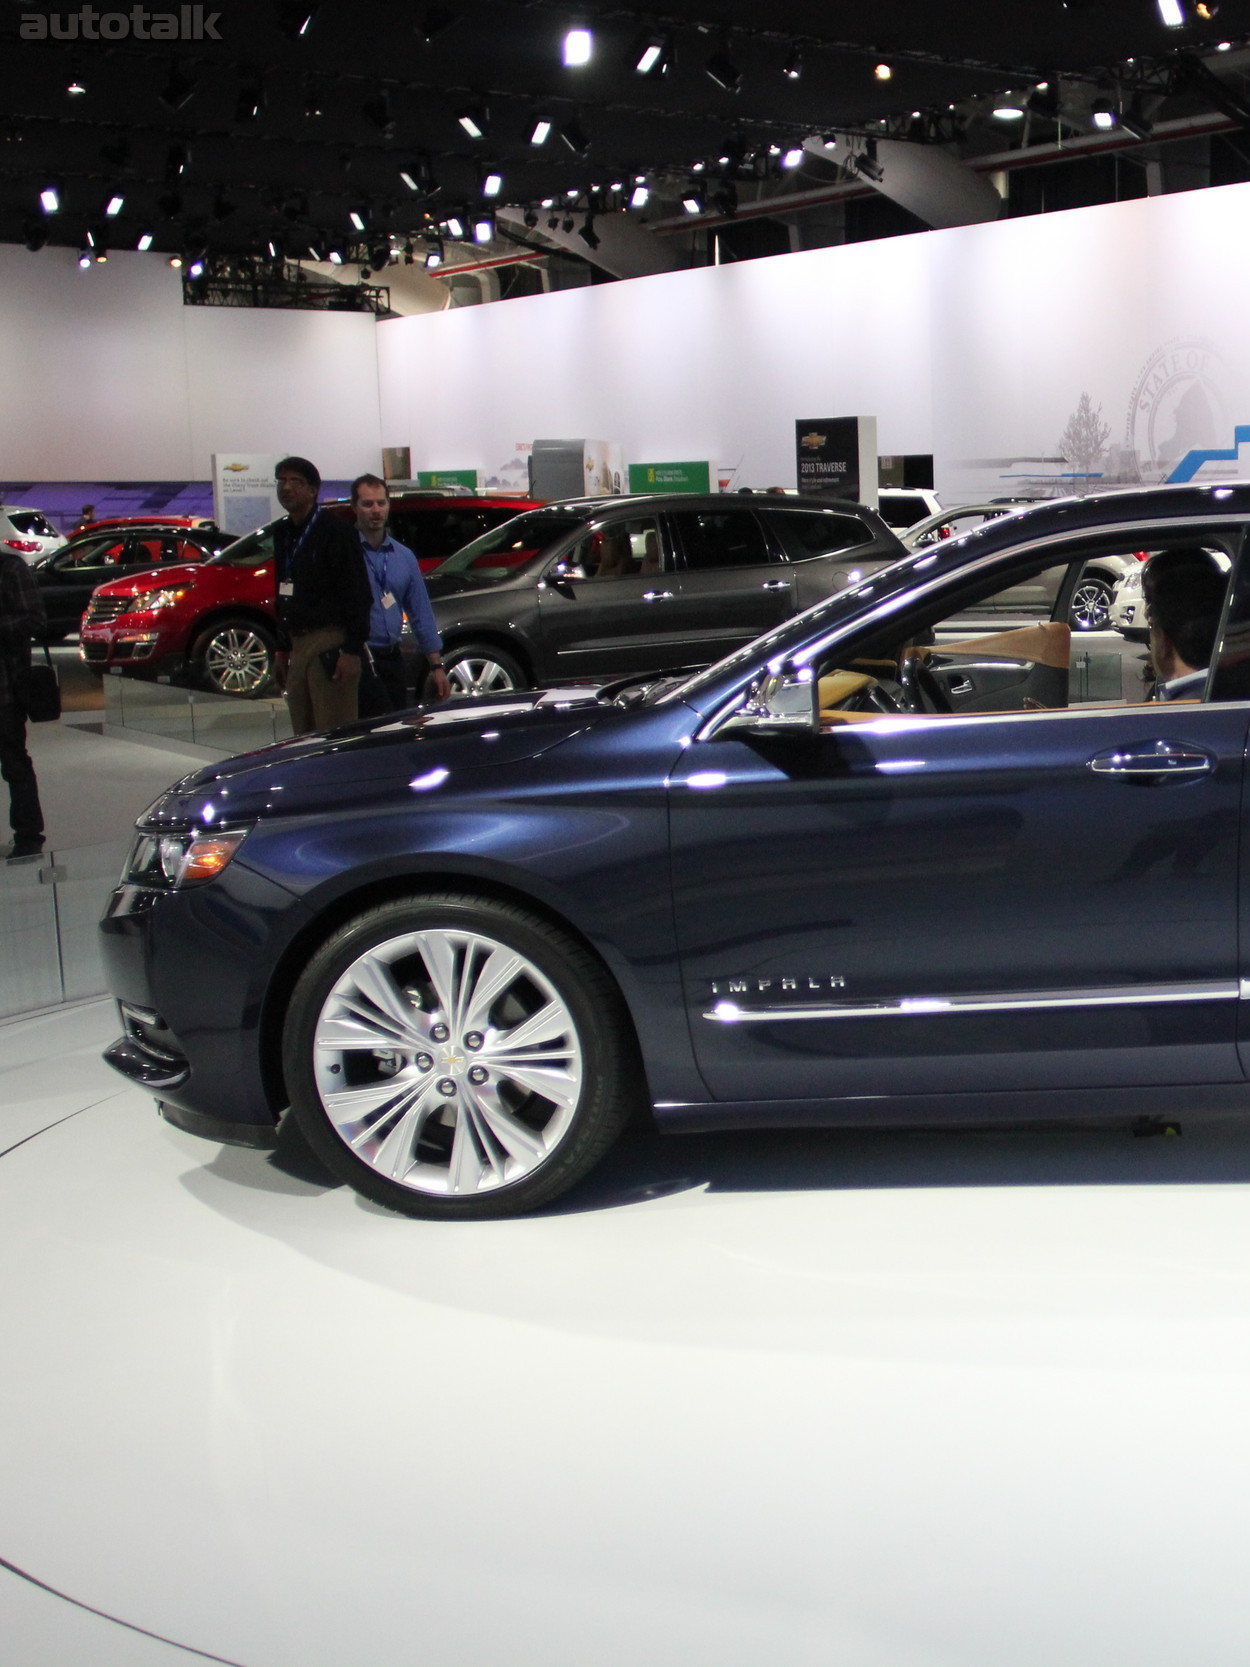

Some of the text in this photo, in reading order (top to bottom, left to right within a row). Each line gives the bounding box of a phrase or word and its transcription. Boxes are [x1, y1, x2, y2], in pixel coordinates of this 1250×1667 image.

[1139, 350, 1211, 413] STATE OF
[801, 462, 847, 473] 2013 TRAVERSE
[711, 975, 845, 993] IMPALA
